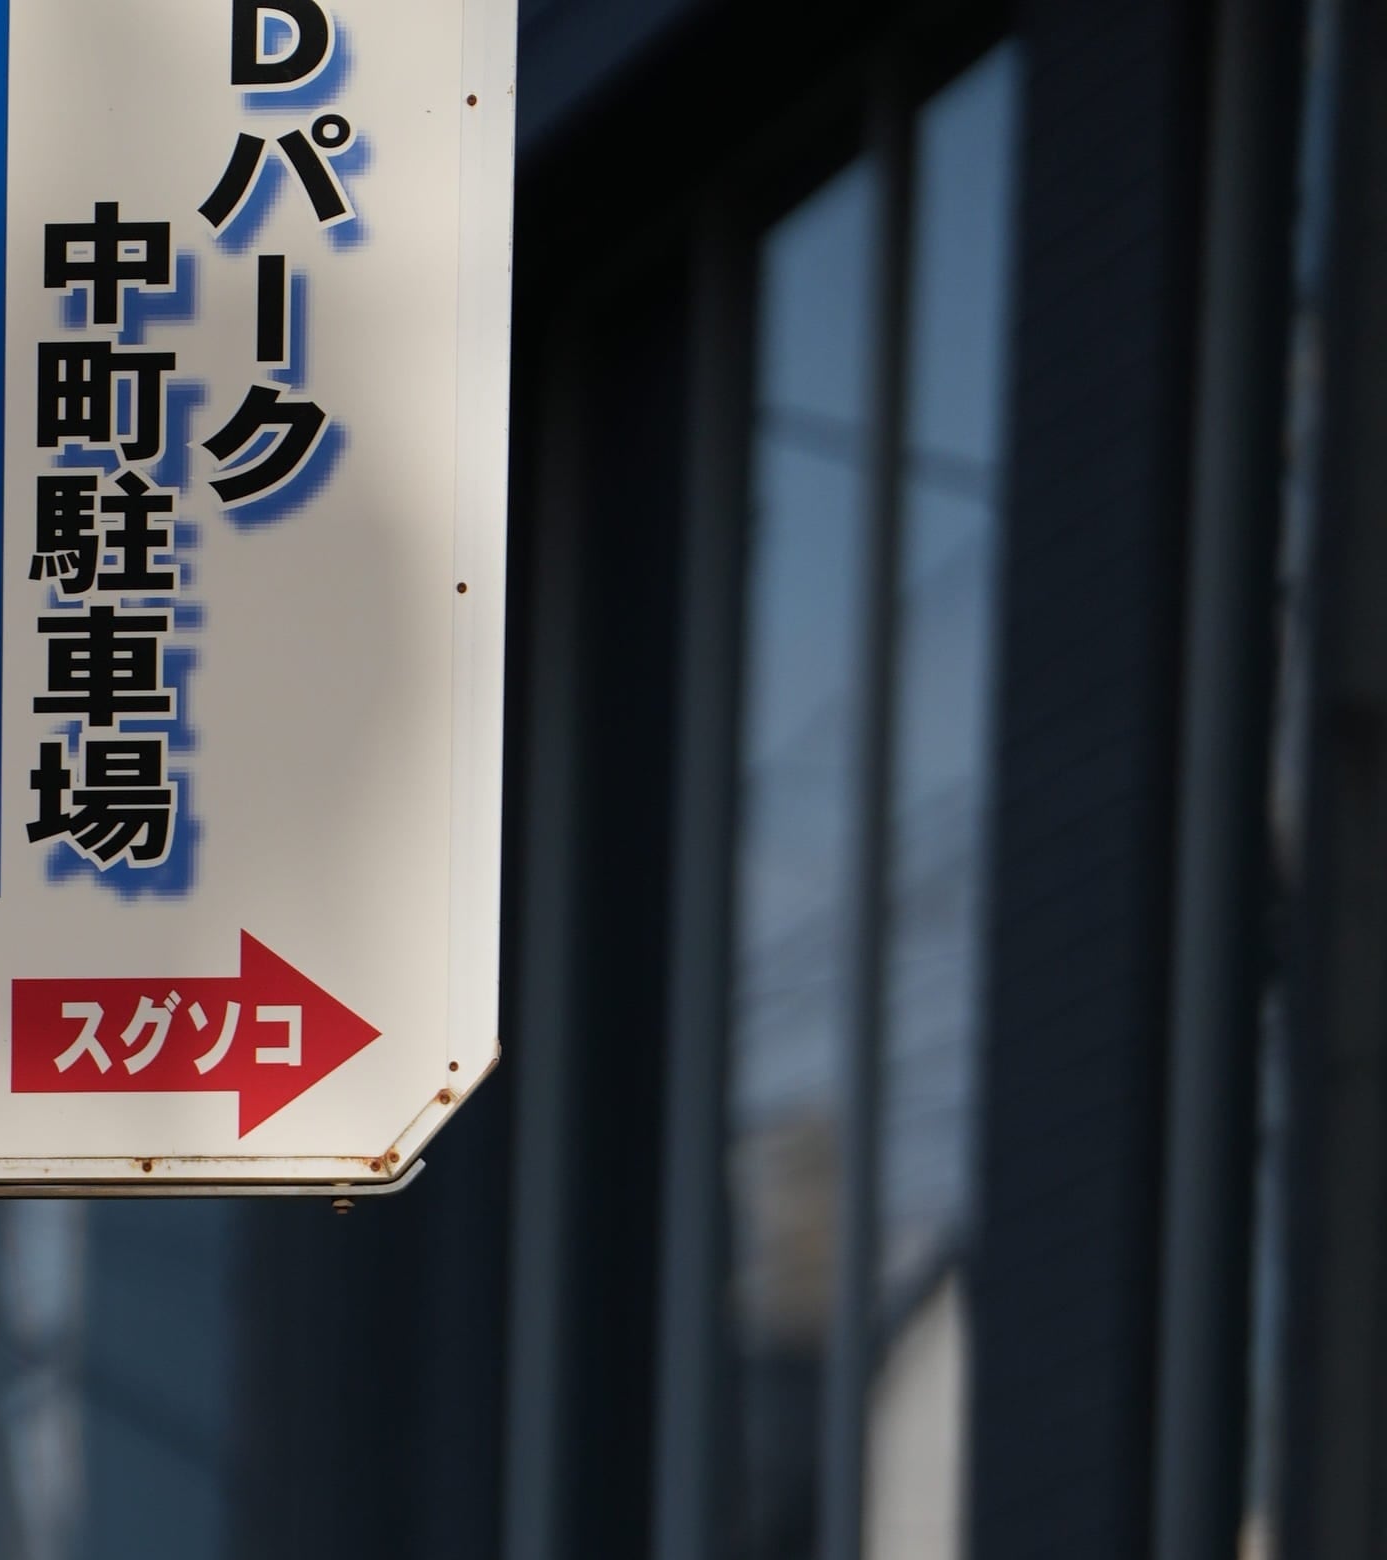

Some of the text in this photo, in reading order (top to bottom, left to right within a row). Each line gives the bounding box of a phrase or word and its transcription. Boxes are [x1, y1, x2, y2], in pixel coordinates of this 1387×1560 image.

[26, 201, 177, 864] 中町駐車場
[53, 989, 304, 1076] スグソコ
